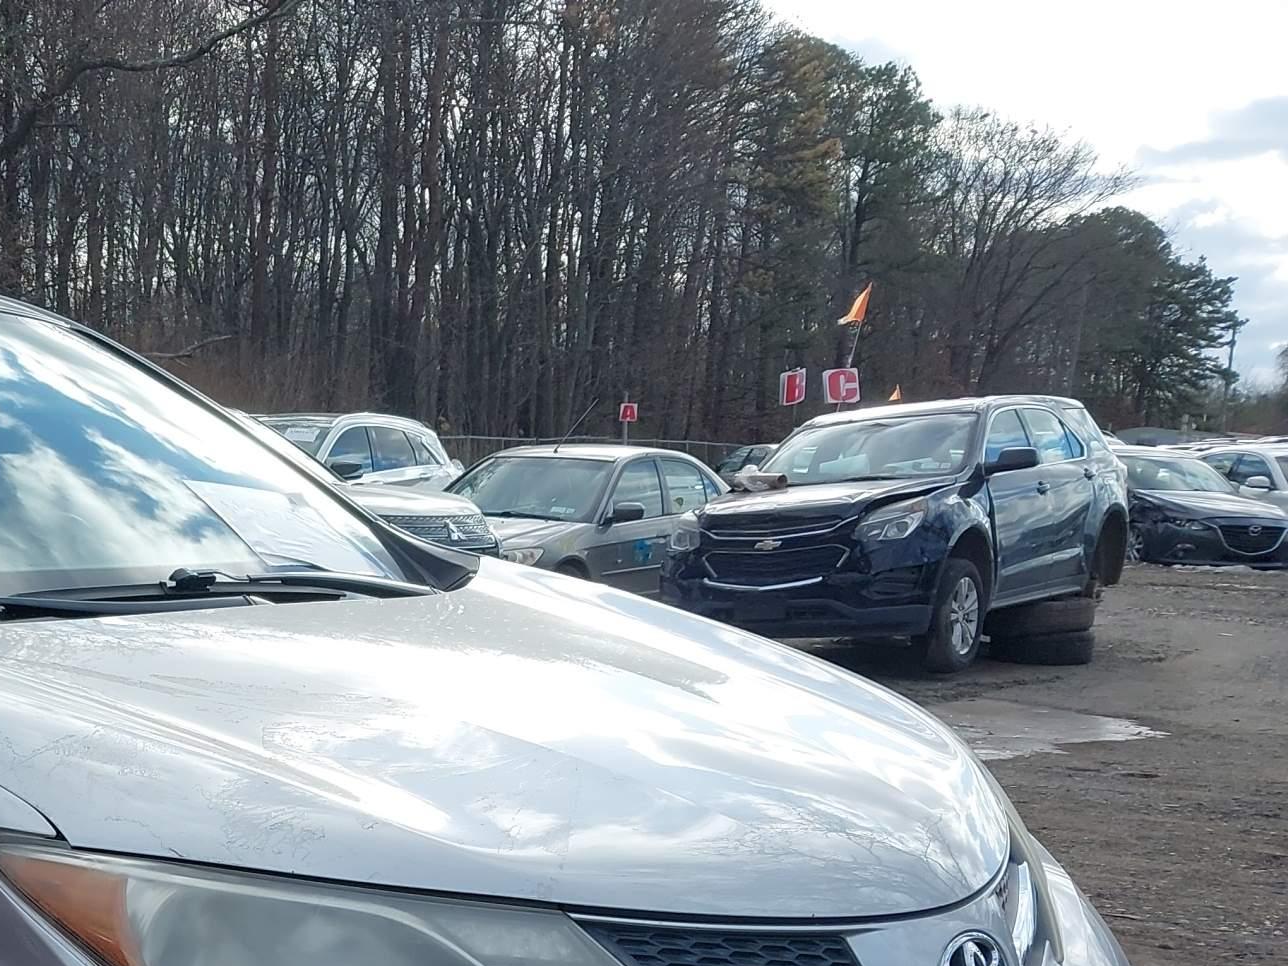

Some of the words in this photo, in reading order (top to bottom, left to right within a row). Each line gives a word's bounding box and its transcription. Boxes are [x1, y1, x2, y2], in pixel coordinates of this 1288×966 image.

[785, 372, 805, 403] B
[828, 369, 858, 401] C
[621, 404, 636, 420] A
